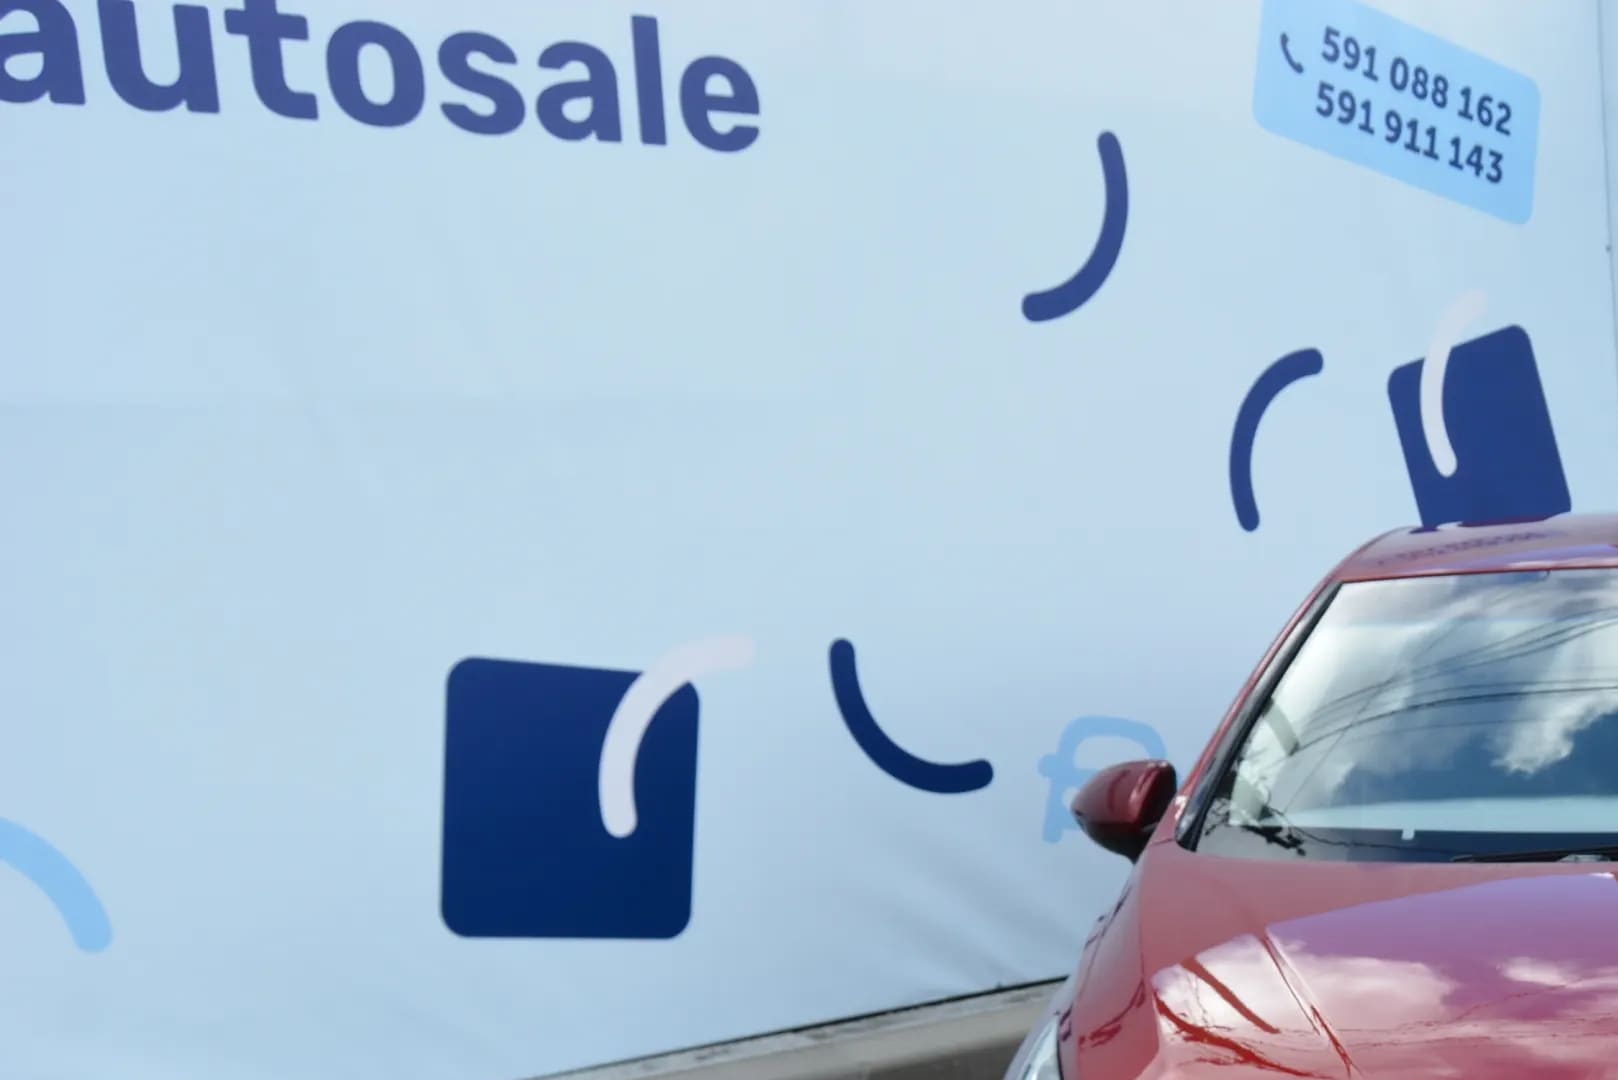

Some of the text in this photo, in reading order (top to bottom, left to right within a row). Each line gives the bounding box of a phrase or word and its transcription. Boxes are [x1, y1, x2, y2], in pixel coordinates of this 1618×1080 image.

[0, 0, 760, 153] autosale
[1322, 27, 1513, 137] 591 088 162
[1316, 81, 1504, 185] 591 911 143
